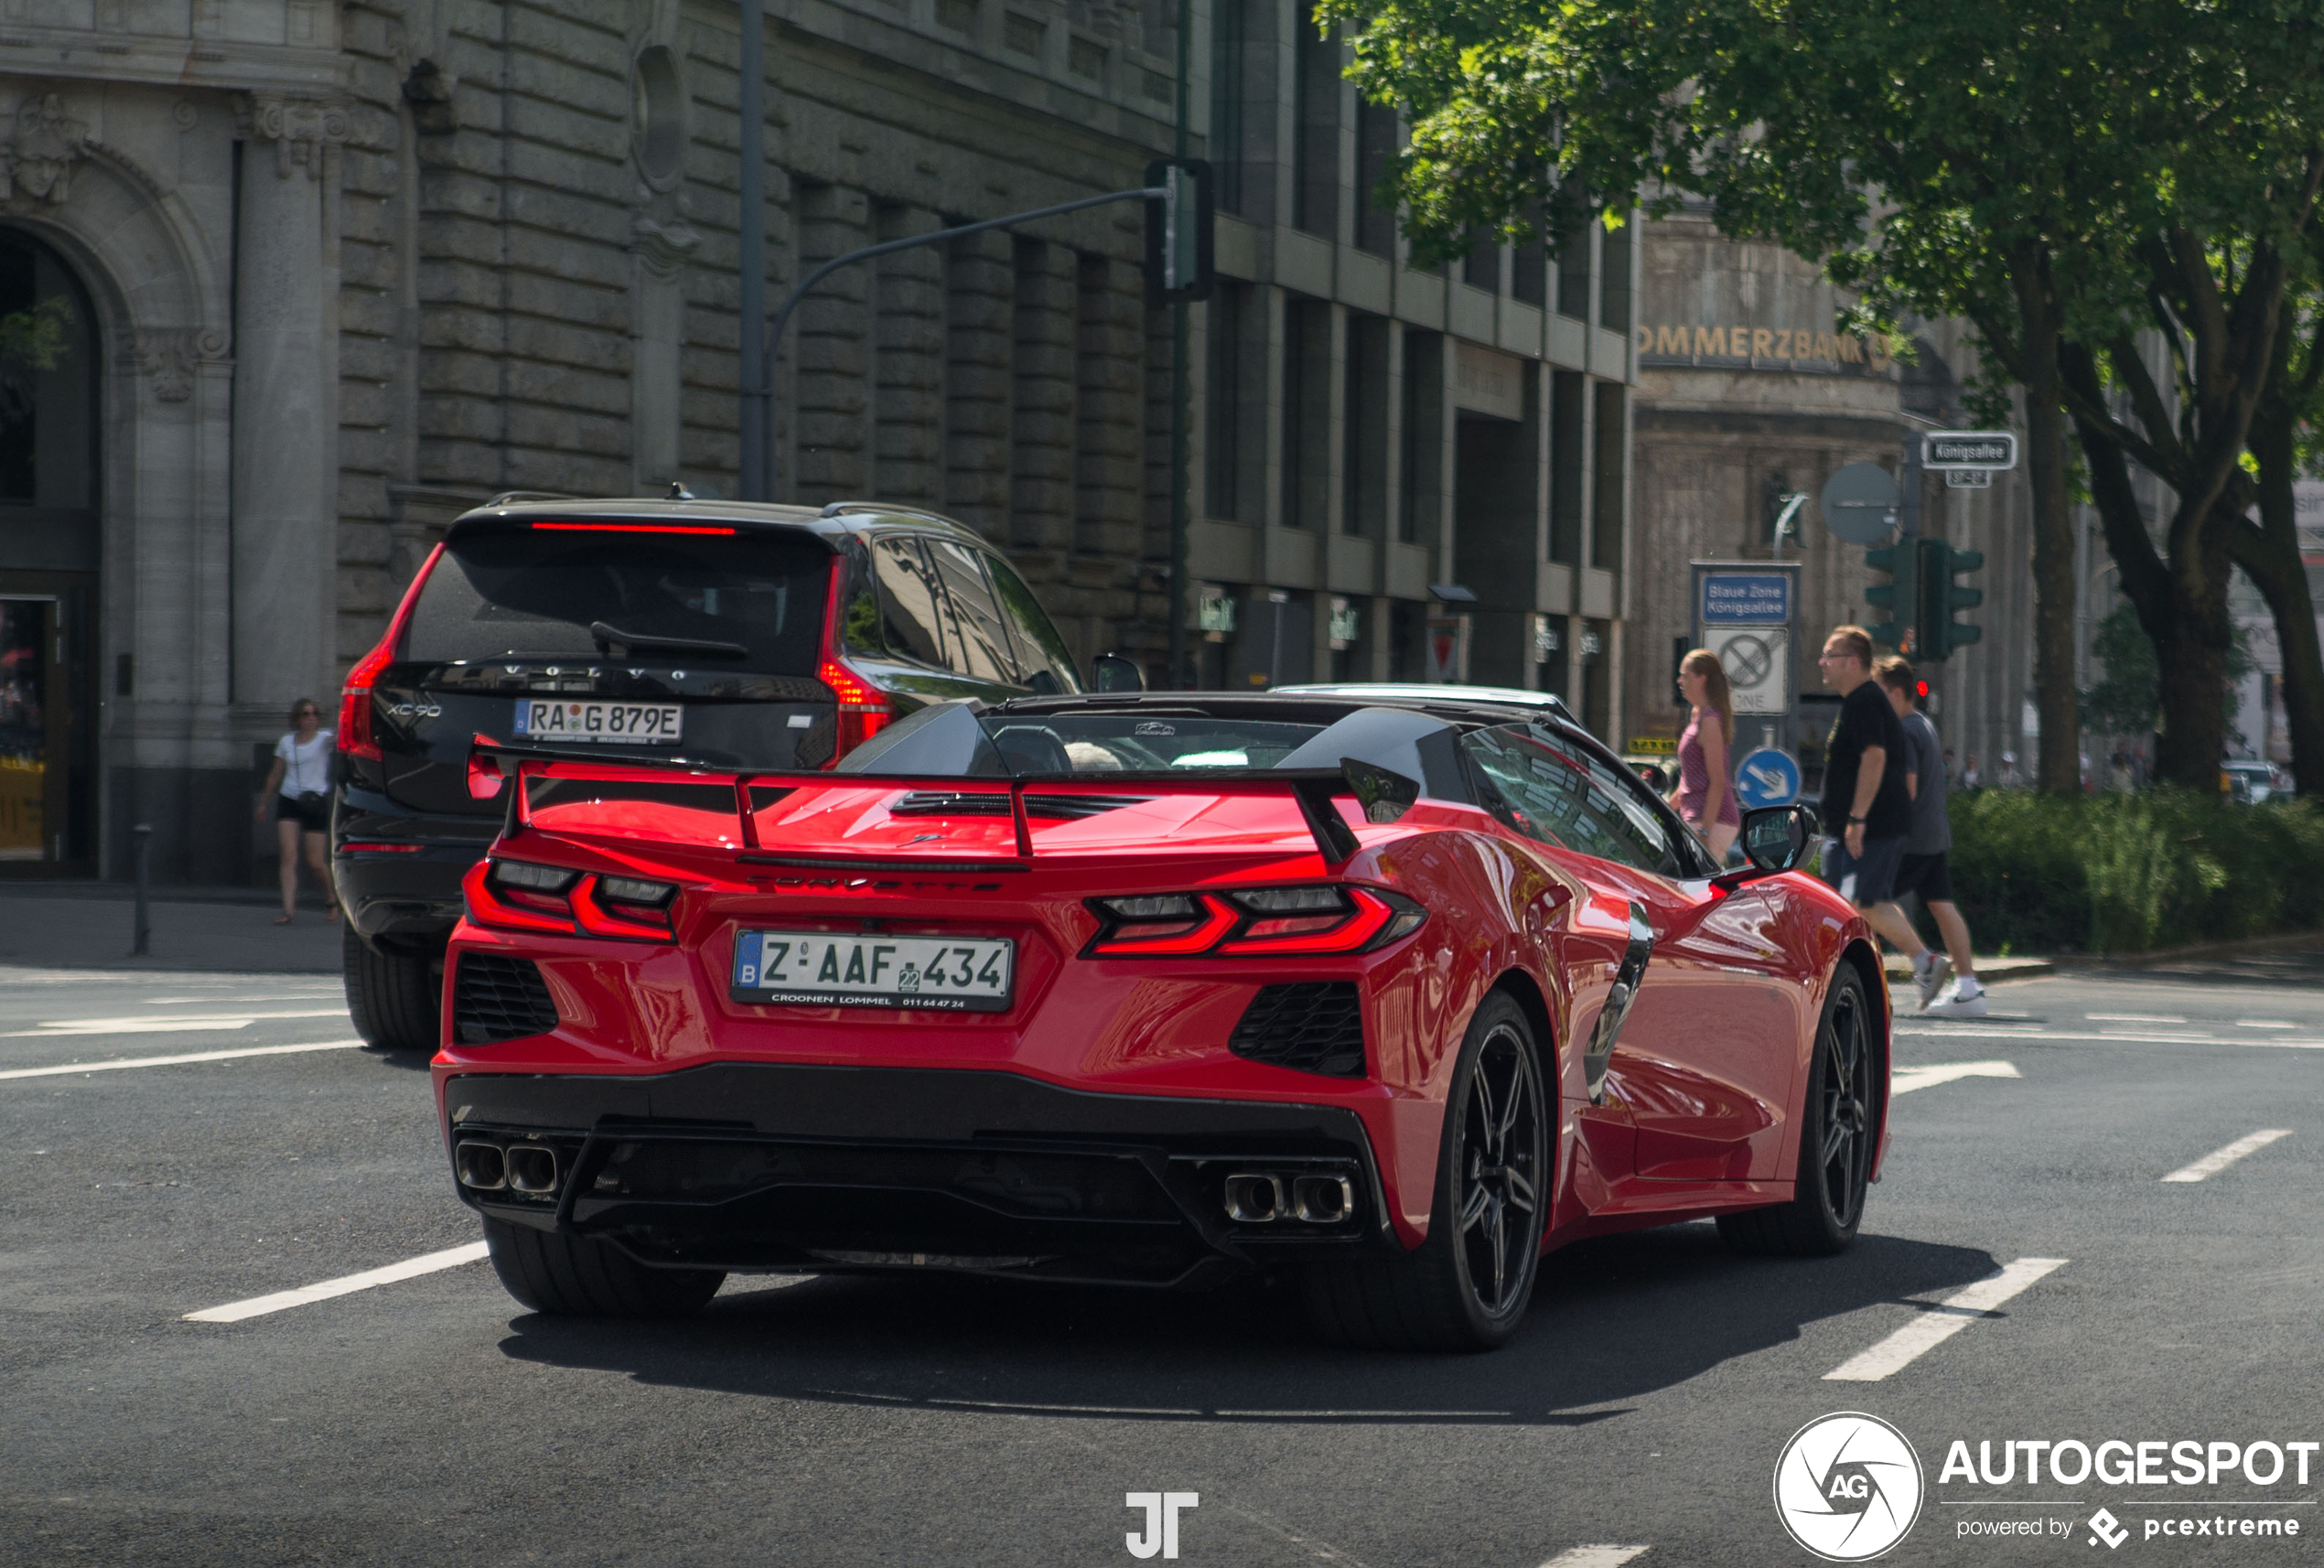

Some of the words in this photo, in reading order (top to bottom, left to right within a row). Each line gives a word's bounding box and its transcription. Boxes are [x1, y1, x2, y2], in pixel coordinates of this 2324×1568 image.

[1638, 325, 1863, 363] OMMERZBANK
[1935, 443, 2005, 461] Königsallee
[1708, 585, 1746, 598] Blaue
[1749, 585, 1781, 598] Zone
[1707, 600, 1783, 616] Königsallee
[504, 664, 685, 681] VOLVO
[1733, 694, 1766, 708] ONE
[531, 703, 565, 730] RA
[586, 705, 603, 732] G
[609, 706, 677, 735] 879E
[747, 875, 1003, 891] CORVETTE
[741, 965, 756, 983] B
[771, 994, 834, 1004] CROONEN
[839, 996, 891, 1005] LOMMEL
[903, 998, 920, 1006] 011
[923, 999, 935, 1007] 64
